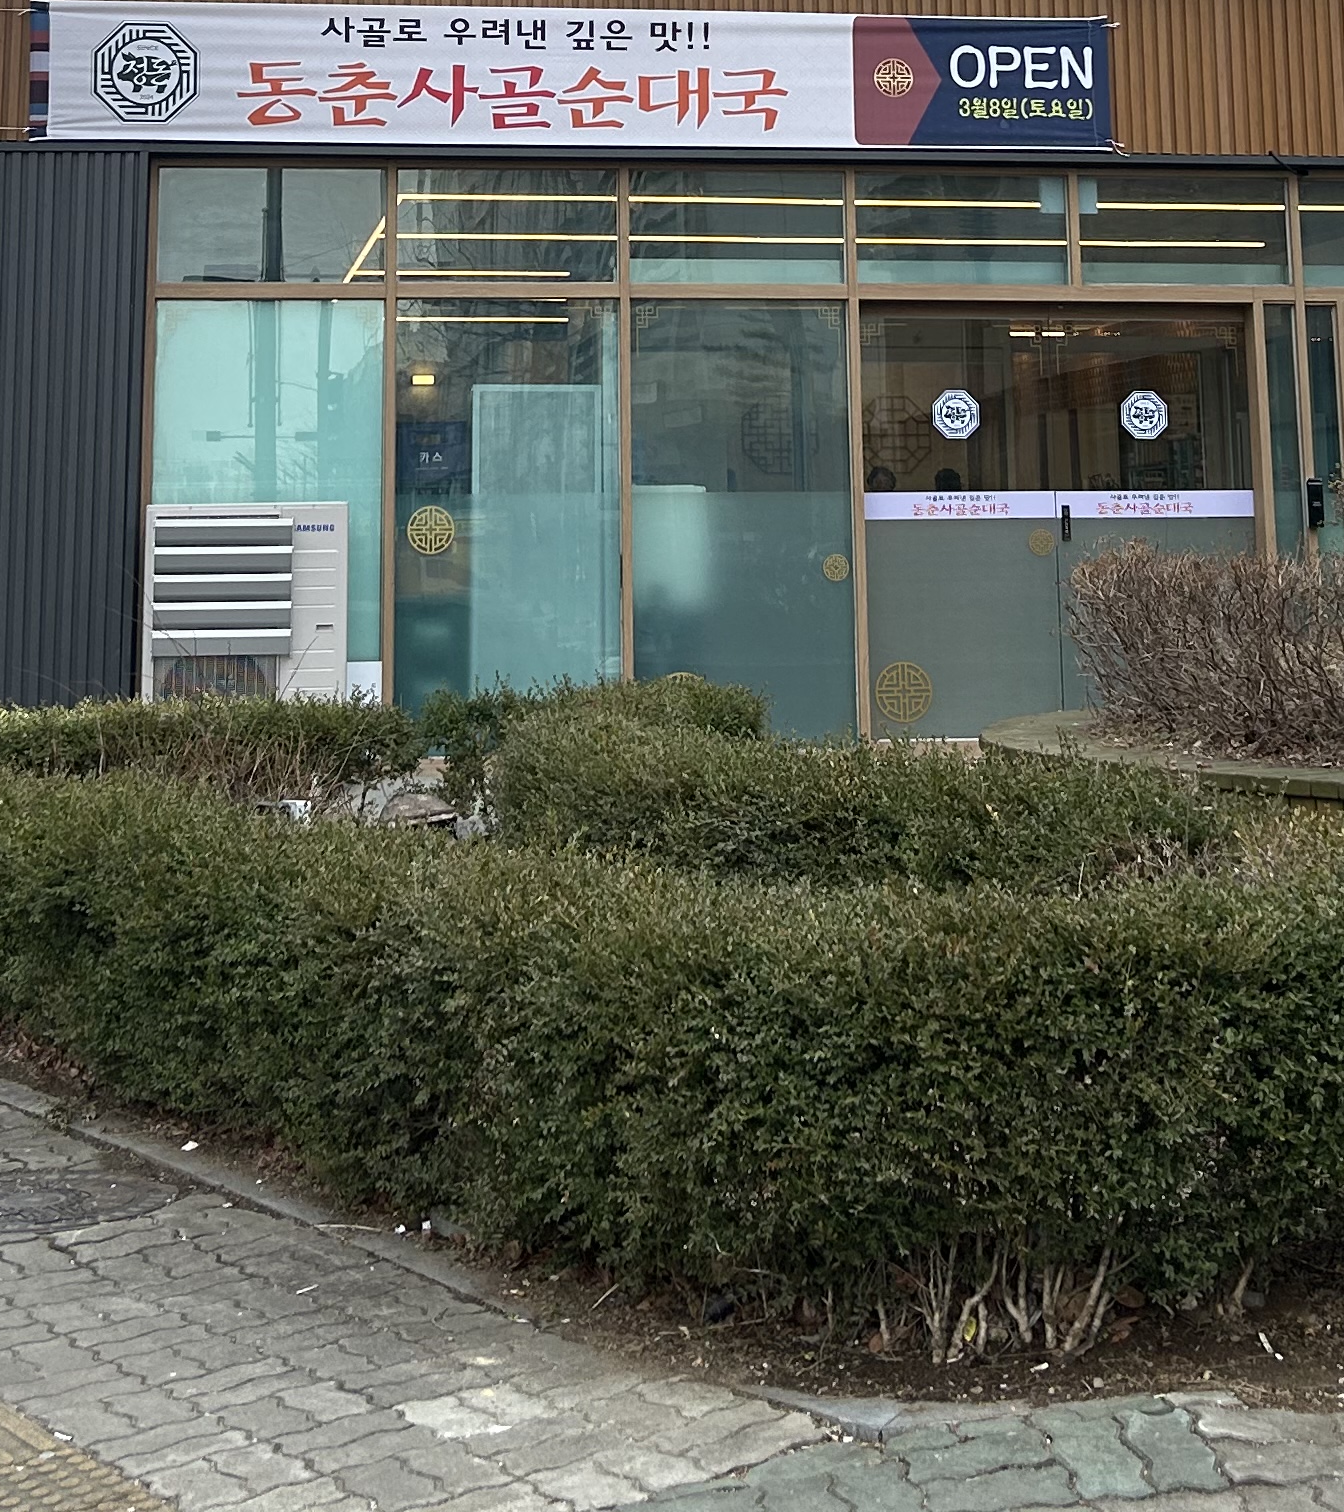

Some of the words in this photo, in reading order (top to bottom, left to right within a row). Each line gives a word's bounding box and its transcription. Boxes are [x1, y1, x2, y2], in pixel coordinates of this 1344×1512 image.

[320, 17, 428, 48] 사골로
[443, 17, 548, 50] 우려낸
[565, 20, 634, 51] 깊은
[649, 21, 712, 52] 맛!!
[949, 44, 1093, 90] OPEN
[236, 60, 789, 134] 동춘사골순대국
[958, 97, 1093, 120] 3월8일(토요일)
[294, 524, 335, 532] AMSUNG
